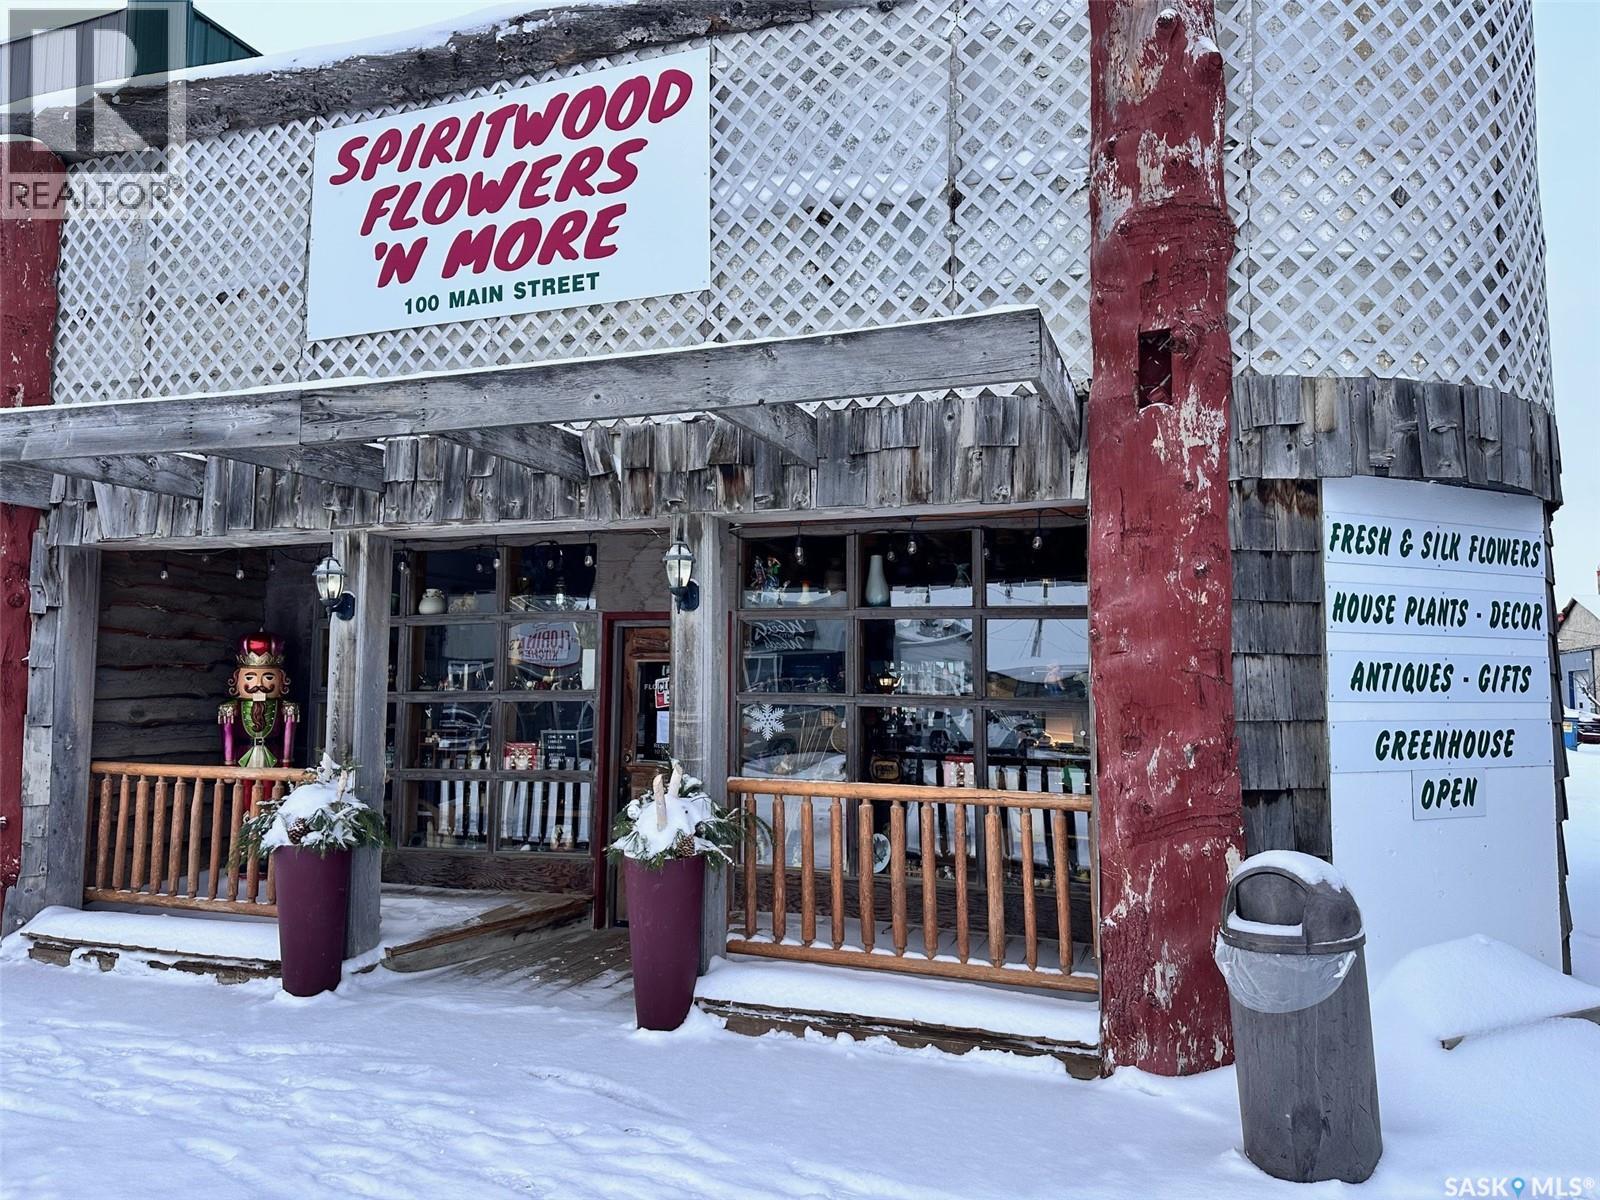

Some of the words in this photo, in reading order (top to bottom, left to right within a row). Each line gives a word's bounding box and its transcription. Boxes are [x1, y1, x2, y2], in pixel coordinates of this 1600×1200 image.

[328, 68, 694, 186] SPIRITWOOD
[359, 137, 649, 237] FLOWERS
[374, 236, 429, 289] 'N
[440, 202, 628, 280] MORE
[404, 293, 440, 316] 100
[448, 284, 504, 309] MAIN
[513, 271, 601, 300] STREET
[1329, 522, 1392, 557] FRESH
[1400, 528, 1414, 558] &
[1421, 530, 1462, 562] SILK
[1468, 534, 1542, 568] FLOWERS
[1332, 591, 1397, 625] HOUSE
[1404, 596, 1469, 628] PLANTS
[1489, 601, 1543, 631] DECOR
[1350, 661, 1455, 695] ANTIQUES
[1478, 664, 1533, 693] GIFTS
[1375, 728, 1516, 762] GREENHOUSE
[1421, 777, 1479, 810] OPEN
